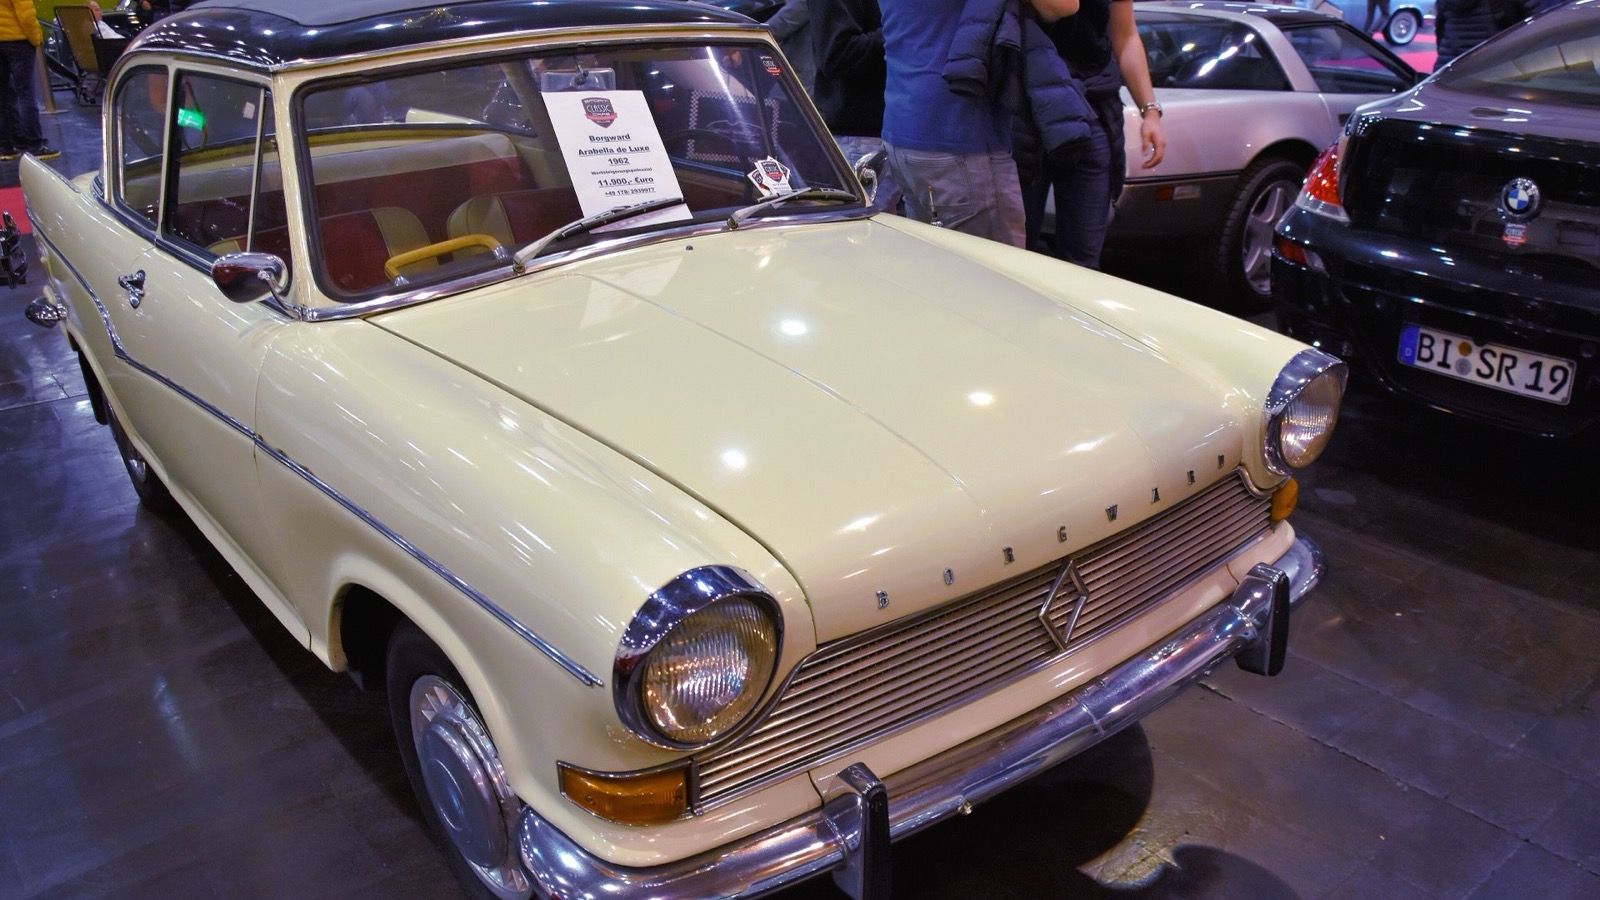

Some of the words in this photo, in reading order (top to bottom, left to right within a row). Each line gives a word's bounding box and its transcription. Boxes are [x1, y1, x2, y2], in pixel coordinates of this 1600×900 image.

[588, 133, 631, 142] Borgward
[578, 147, 614, 156] Arabella
[608, 157, 630, 165] 1962
[1416, 332, 1452, 370] BI
[1476, 348, 1518, 386] SR
[1524, 360, 1570, 396] 19
